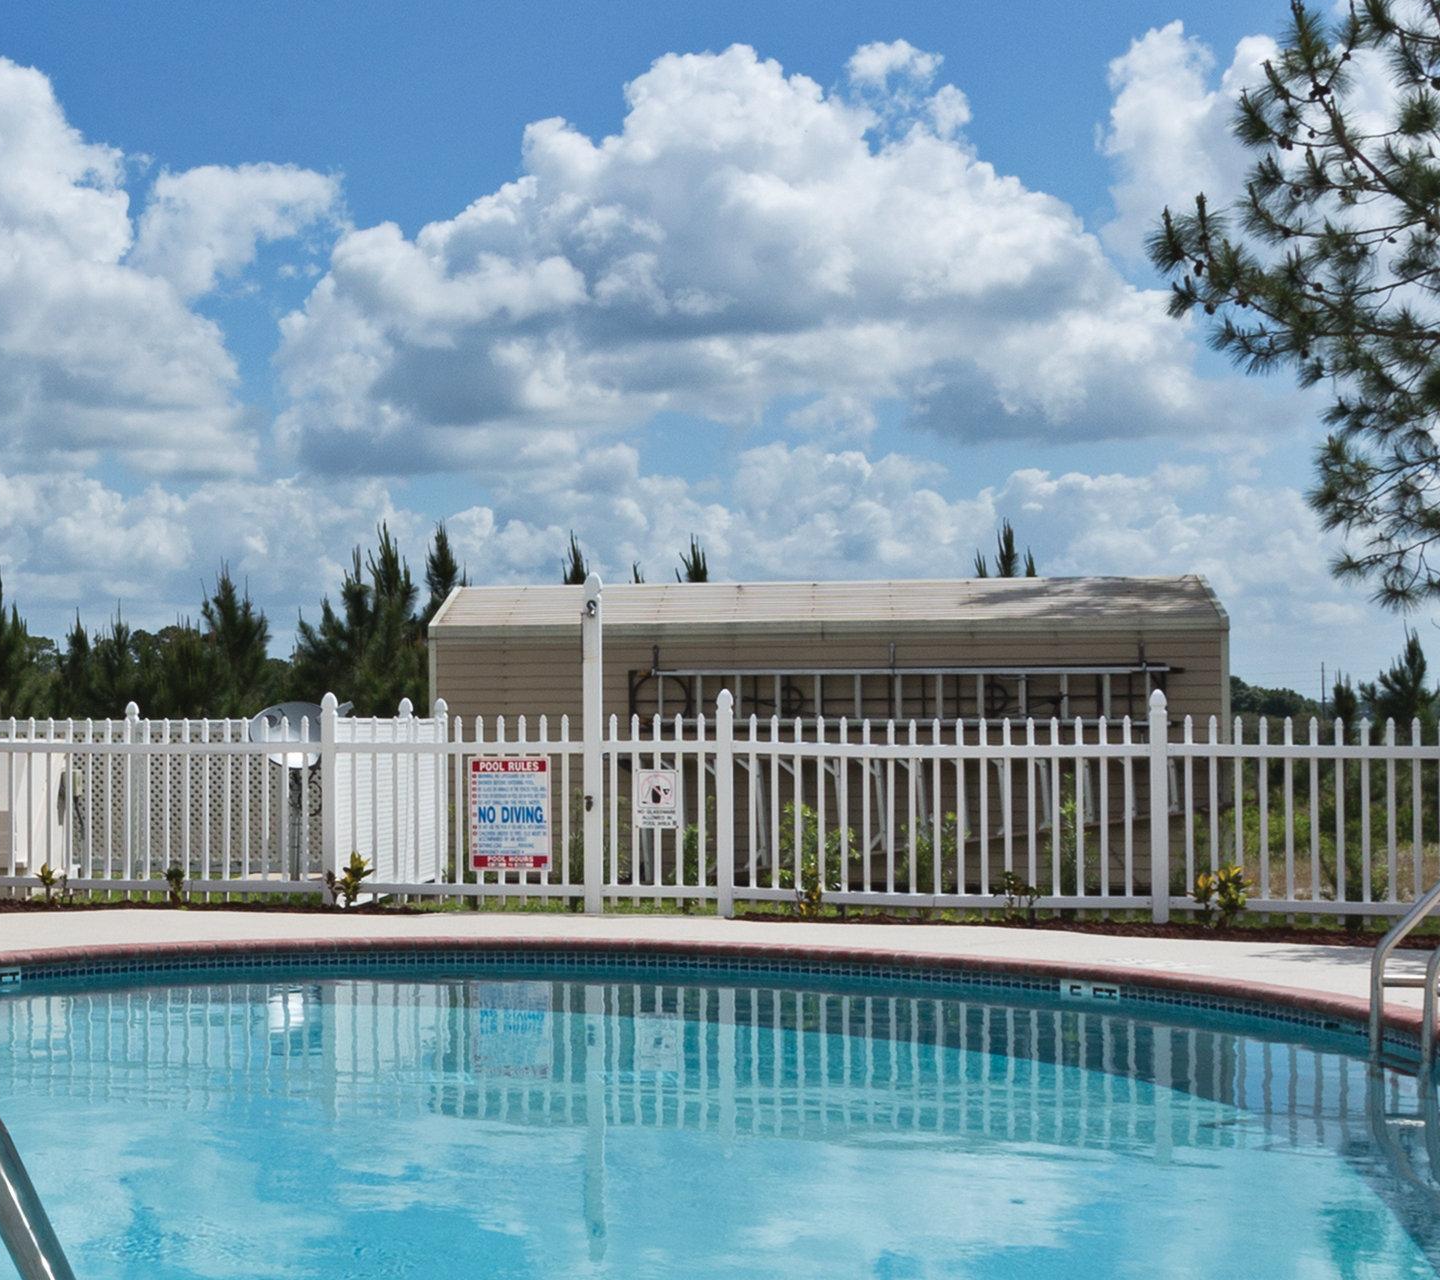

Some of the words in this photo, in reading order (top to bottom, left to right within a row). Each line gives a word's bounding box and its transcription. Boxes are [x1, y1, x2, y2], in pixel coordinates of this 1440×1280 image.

[479, 761, 505, 771] POOL
[507, 761, 540, 771] RULES
[478, 806, 496, 823] NO
[501, 806, 547, 823] DIVING.
